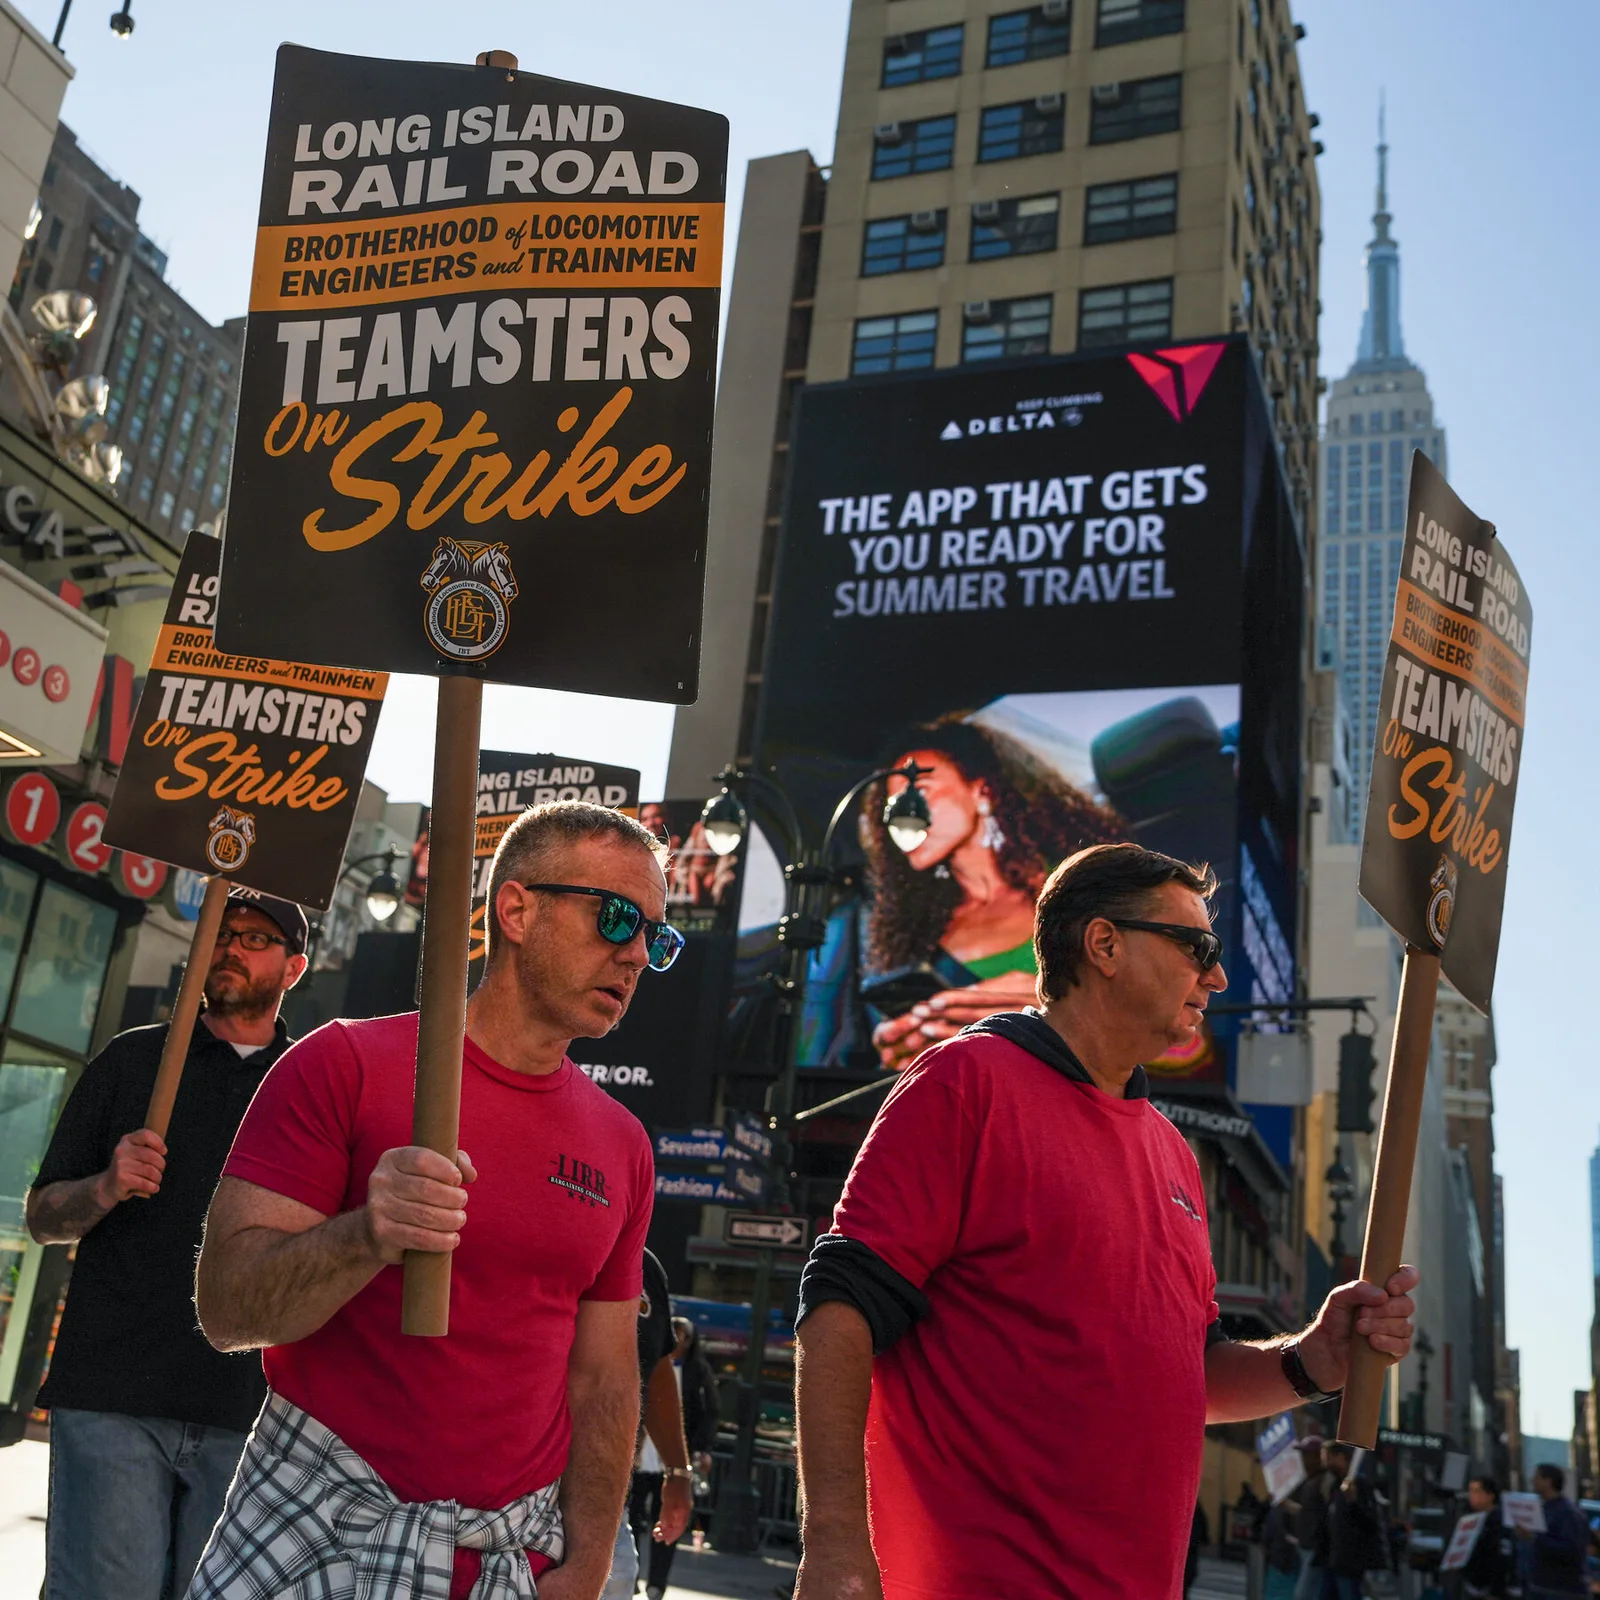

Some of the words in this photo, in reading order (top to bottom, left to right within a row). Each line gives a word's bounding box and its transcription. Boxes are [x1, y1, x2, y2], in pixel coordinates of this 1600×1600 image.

[293, 113, 431, 163] LONG
[442, 104, 625, 148] ISLAND
[287, 156, 467, 216] RAIL
[486, 149, 700, 196] ROAD
[284, 215, 498, 263] BROTHERHOOD
[505, 220, 527, 251] of
[530, 214, 700, 241] LOCOMOTIVE
[279, 251, 477, 297] ENGINEERS
[481, 253, 526, 276] and
[528, 247, 696, 274] TRAINMEN
[277, 294, 693, 406] TEAMSTERS
[264, 401, 349, 457] On
[968, 411, 1055, 436] DELTA
[302, 386, 687, 552] Strike
[819, 494, 892, 535] THE
[898, 485, 977, 529] APP
[985, 476, 1093, 521] THAT
[1101, 464, 1208, 511] GETS
[849, 530, 929, 575] YOU
[939, 521, 1074, 569] READY
[1082, 514, 1165, 557] FOR
[1416, 511, 1461, 565] LONG
[1465, 545, 1519, 606] ISLAND
[475, 582, 500, 608] Engineers
[834, 569, 1007, 618] SUMMER
[1016, 560, 1175, 605] TRAVEL
[1410, 544, 1474, 612] RAIL
[1480, 586, 1528, 658] ROAD
[1402, 617, 1474, 672] ENGINEERS
[1406, 592, 1483, 650] BROTHERHOOD
[166, 650, 270, 676] ENGINEERS
[291, 666, 376, 691] TRAINMEN
[143, 719, 191, 748] On
[156, 675, 367, 746] TEAMSTERS
[1390, 654, 1516, 786] TEAMSTERS
[1383, 718, 1413, 761] On
[155, 731, 349, 812] Strike
[480, 772, 511, 791] NG
[514, 766, 595, 788] ISLAND
[477, 790, 526, 815] AIL
[1387, 746, 1502, 874] Strike
[658, 1136, 720, 1158] Seventh
[550, 1176, 584, 1194] BARGAINING
[655, 1176, 714, 1197] Fashion
